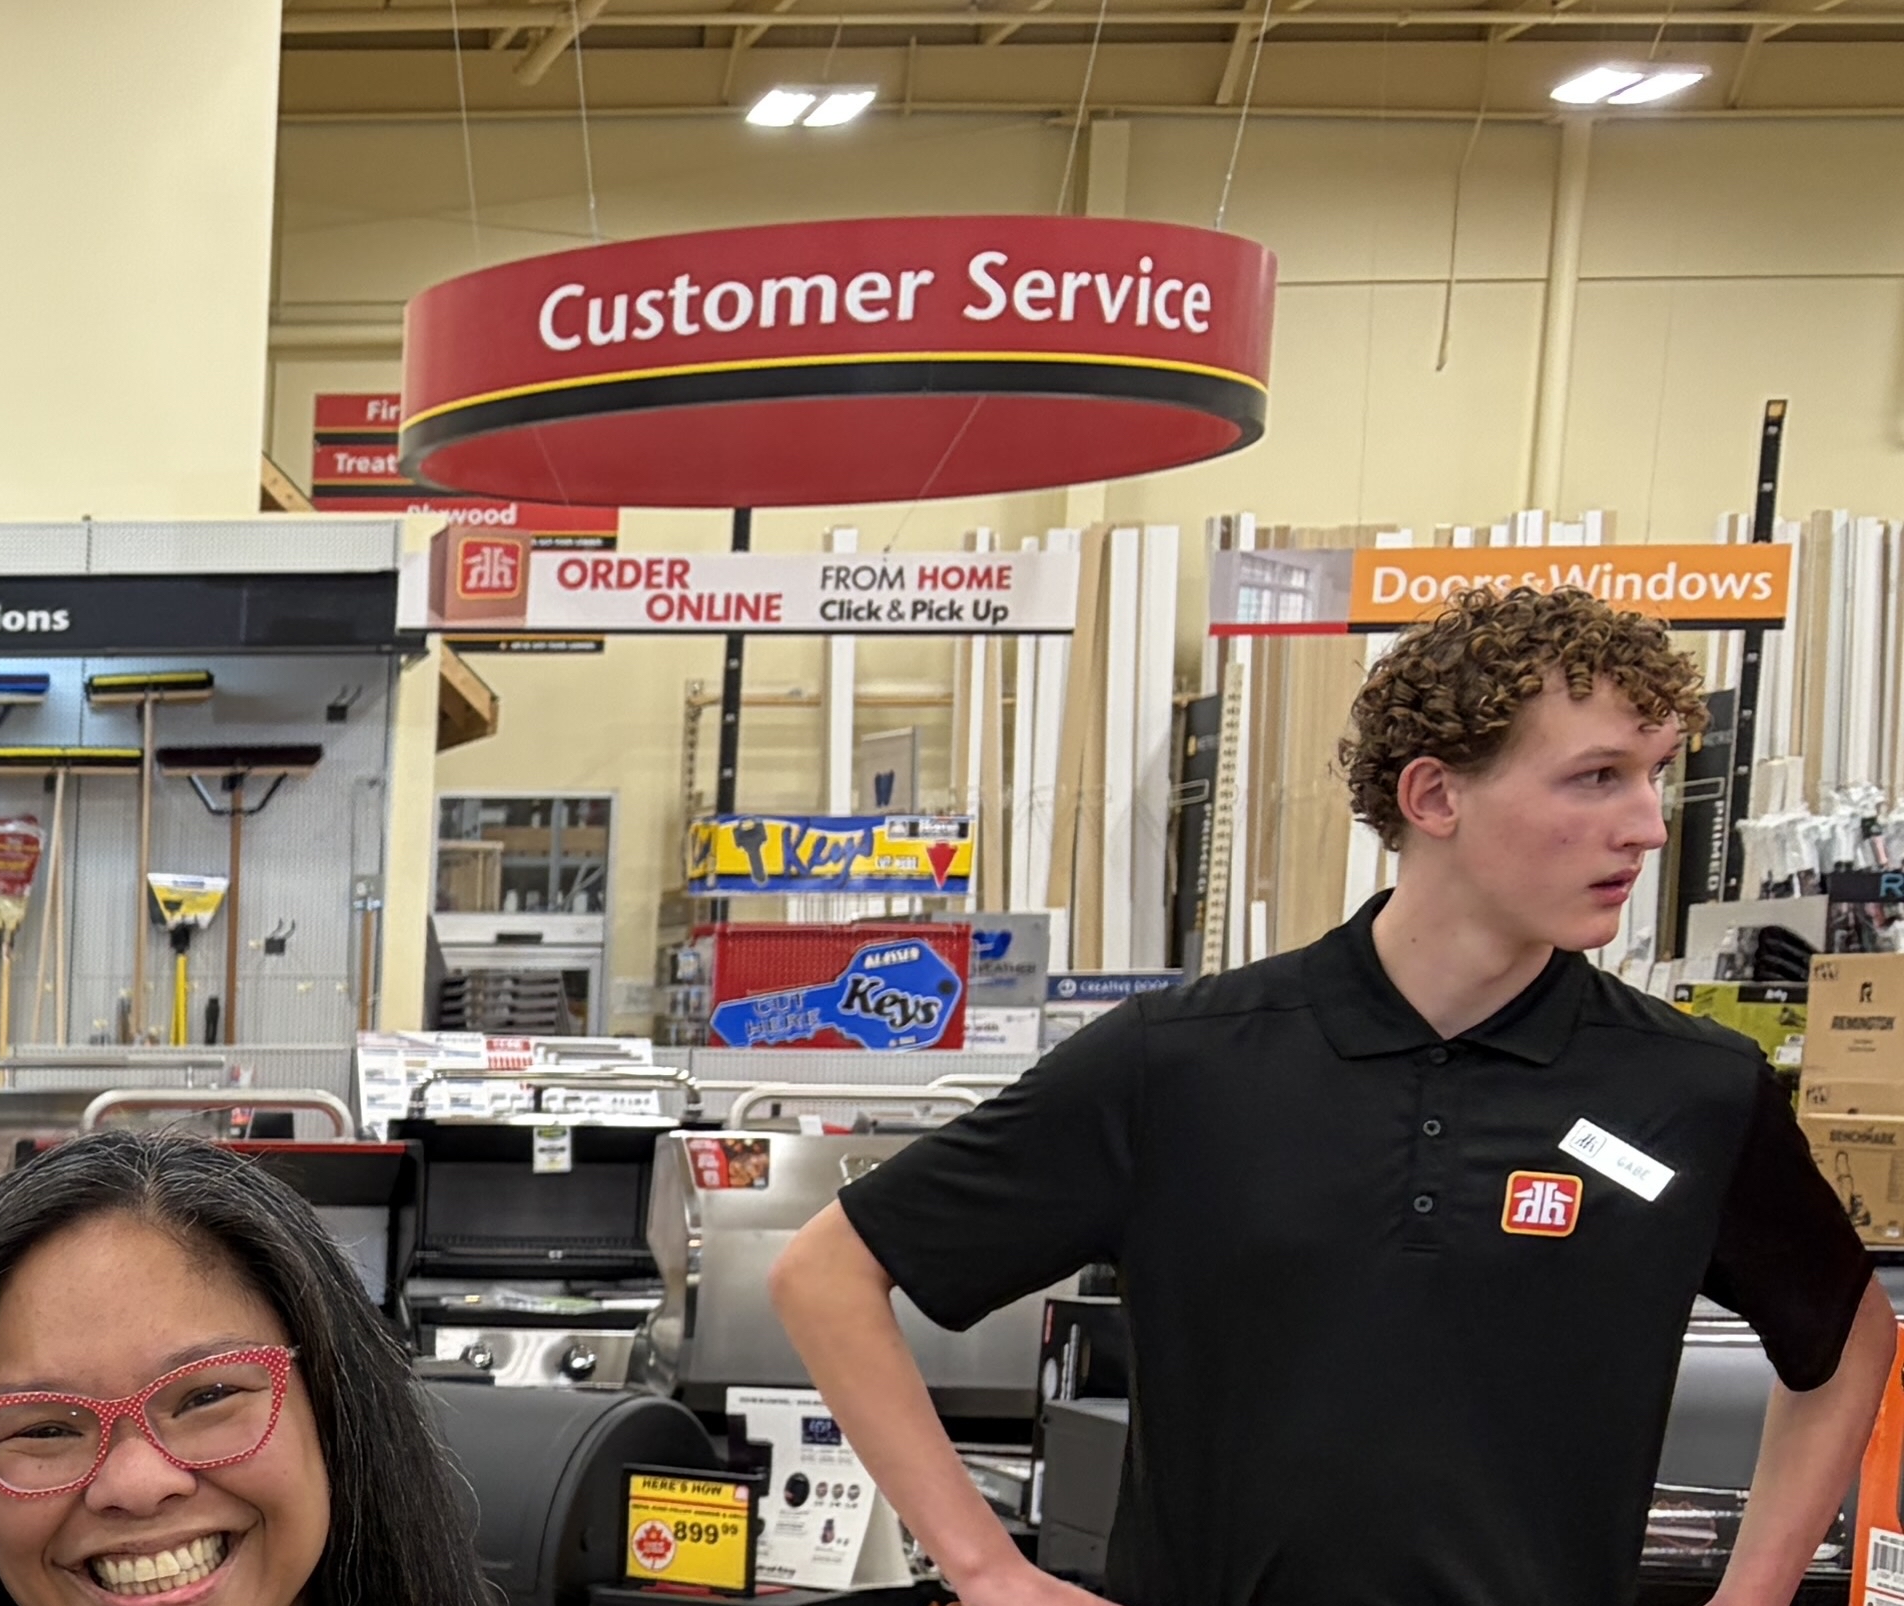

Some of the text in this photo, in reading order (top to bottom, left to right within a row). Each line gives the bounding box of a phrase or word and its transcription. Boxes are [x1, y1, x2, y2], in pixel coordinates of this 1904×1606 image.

[537, 251, 1212, 350] Customer Service
[335, 453, 398, 473] Treat
[556, 559, 690, 590] ORDER
[820, 565, 1011, 592] FROM HOME
[1548, 563, 1773, 602] Windows
[646, 592, 782, 622] ONLINE
[819, 597, 1008, 626] Click & Pick Up
[839, 975, 942, 1029] Keys
[1617, 1156, 1651, 1182] GABE
[691, 1481, 724, 1496] HOW
[673, 1520, 720, 1545] 899
